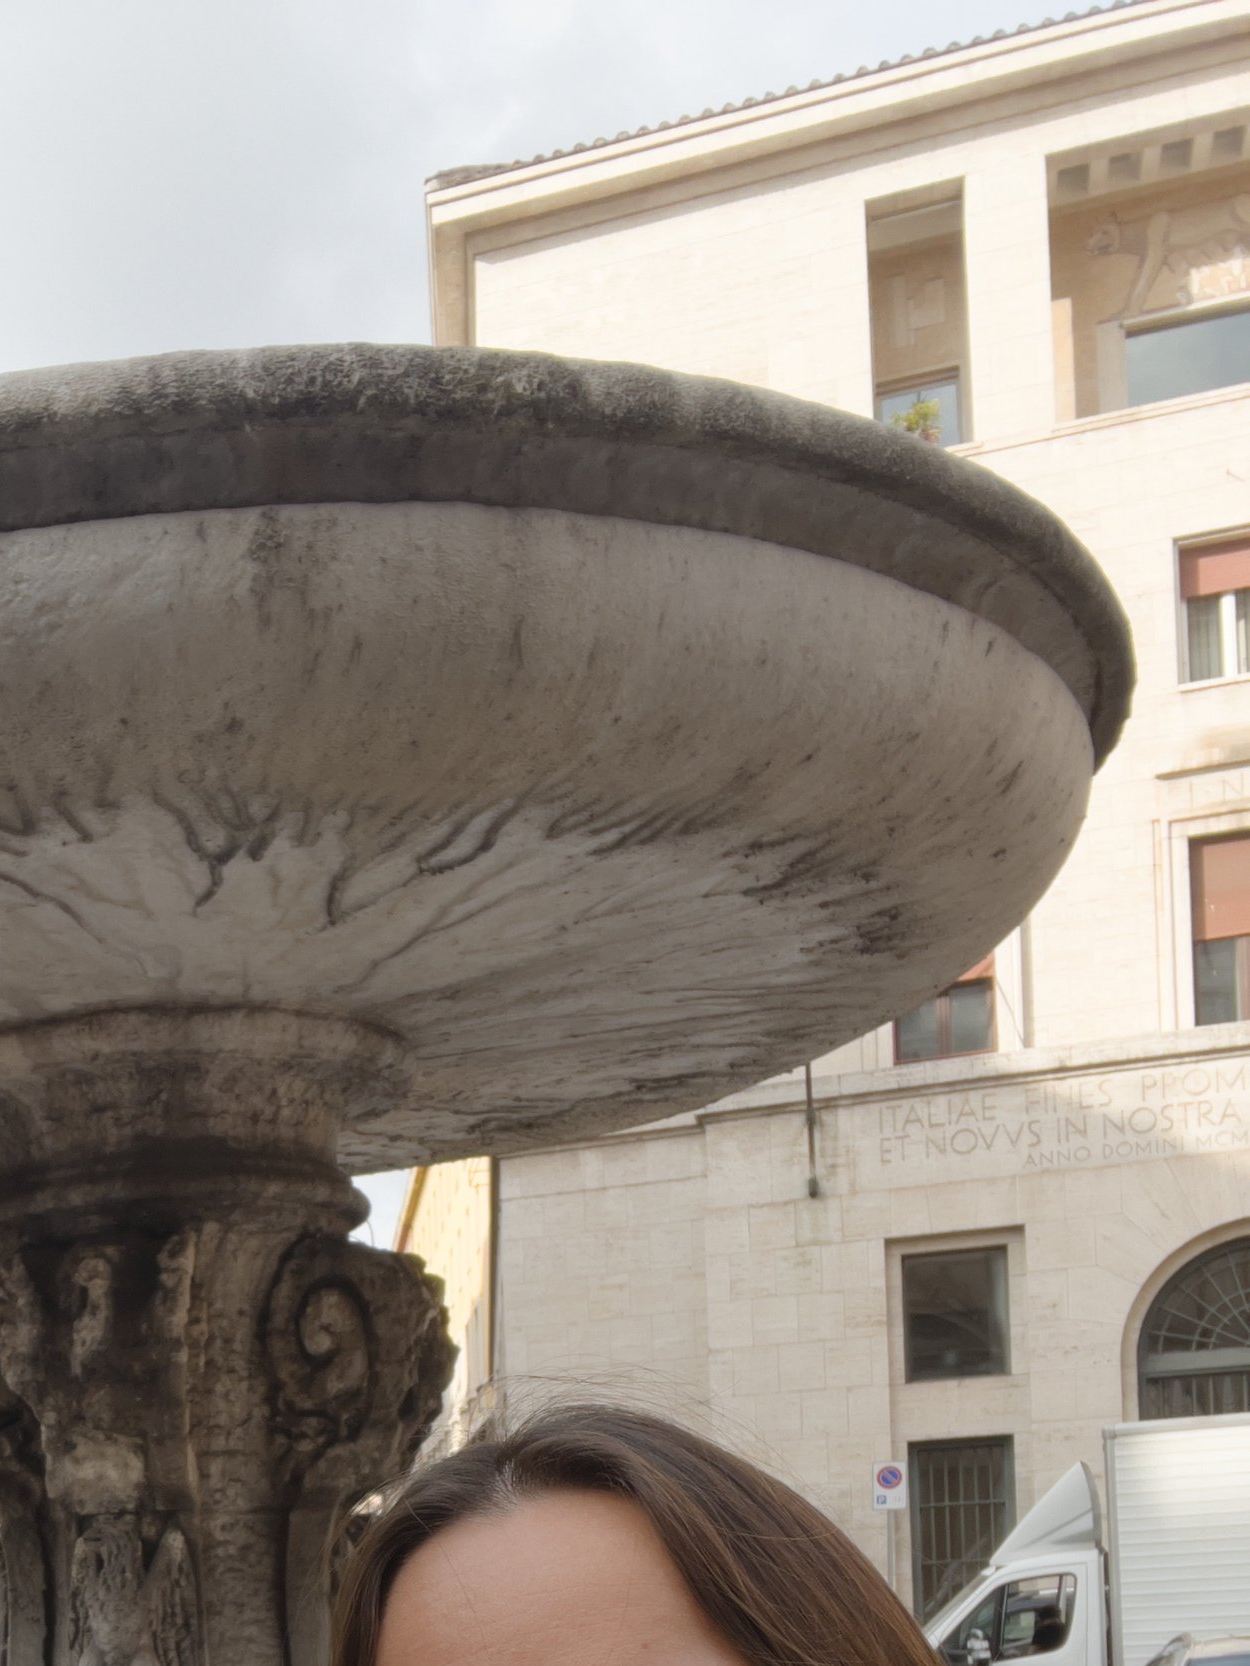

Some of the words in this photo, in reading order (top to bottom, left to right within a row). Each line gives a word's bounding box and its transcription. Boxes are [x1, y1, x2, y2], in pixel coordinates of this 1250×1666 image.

[879, 1093, 997, 1133] ITALIAE
[880, 1134, 911, 1165] ET
[925, 1120, 1042, 1160] NOVVS
[1057, 1114, 1088, 1144] IN
[1102, 1099, 1242, 1140] NOSTRA
[1023, 1146, 1091, 1168] ANNO
[1102, 1136, 1184, 1160] DOMINI
